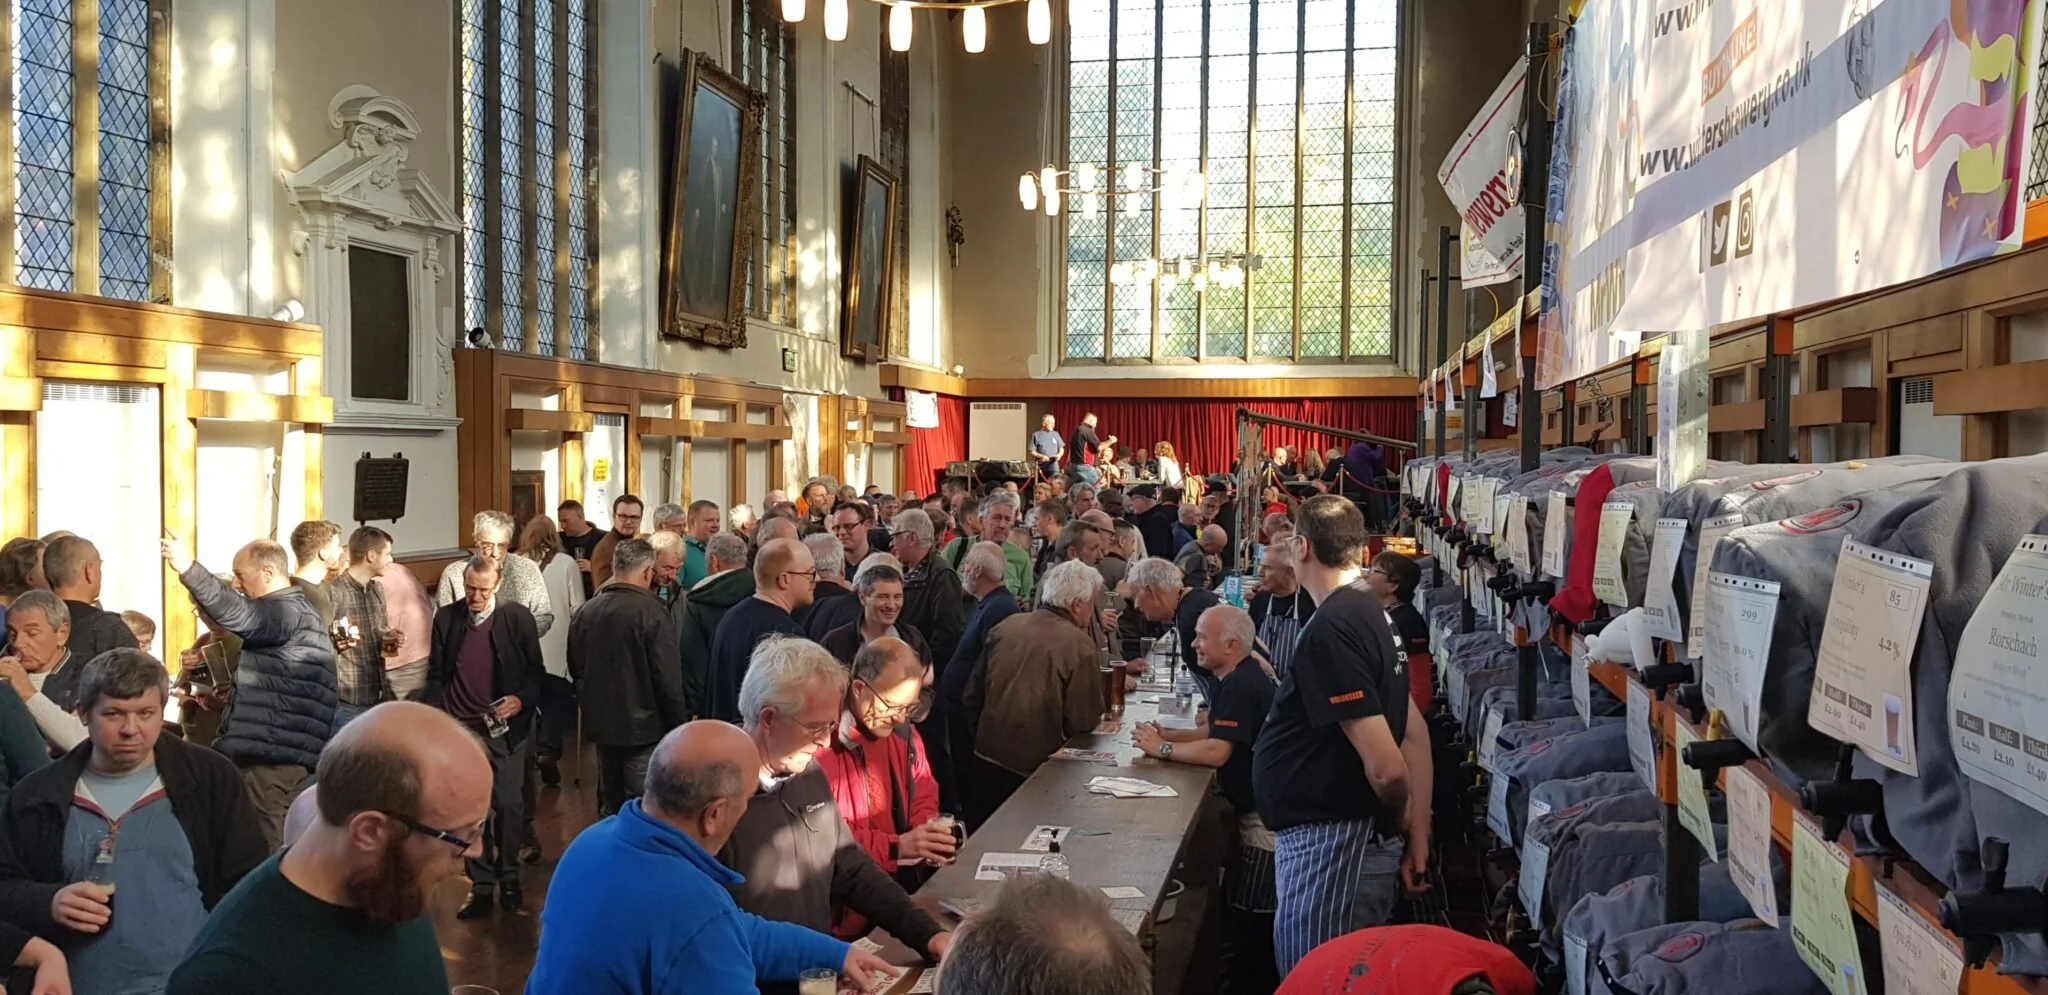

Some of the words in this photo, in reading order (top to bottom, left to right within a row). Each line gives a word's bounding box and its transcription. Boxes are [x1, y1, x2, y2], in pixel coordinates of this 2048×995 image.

[1889, 590, 1901, 607] 85
[1741, 608, 1758, 620] 299
[1988, 626, 2037, 658] Rorschach
[1995, 727, 2014, 746] Half:
[1993, 748, 2015, 768] £2.10
[2026, 761, 2047, 783] £1.40
